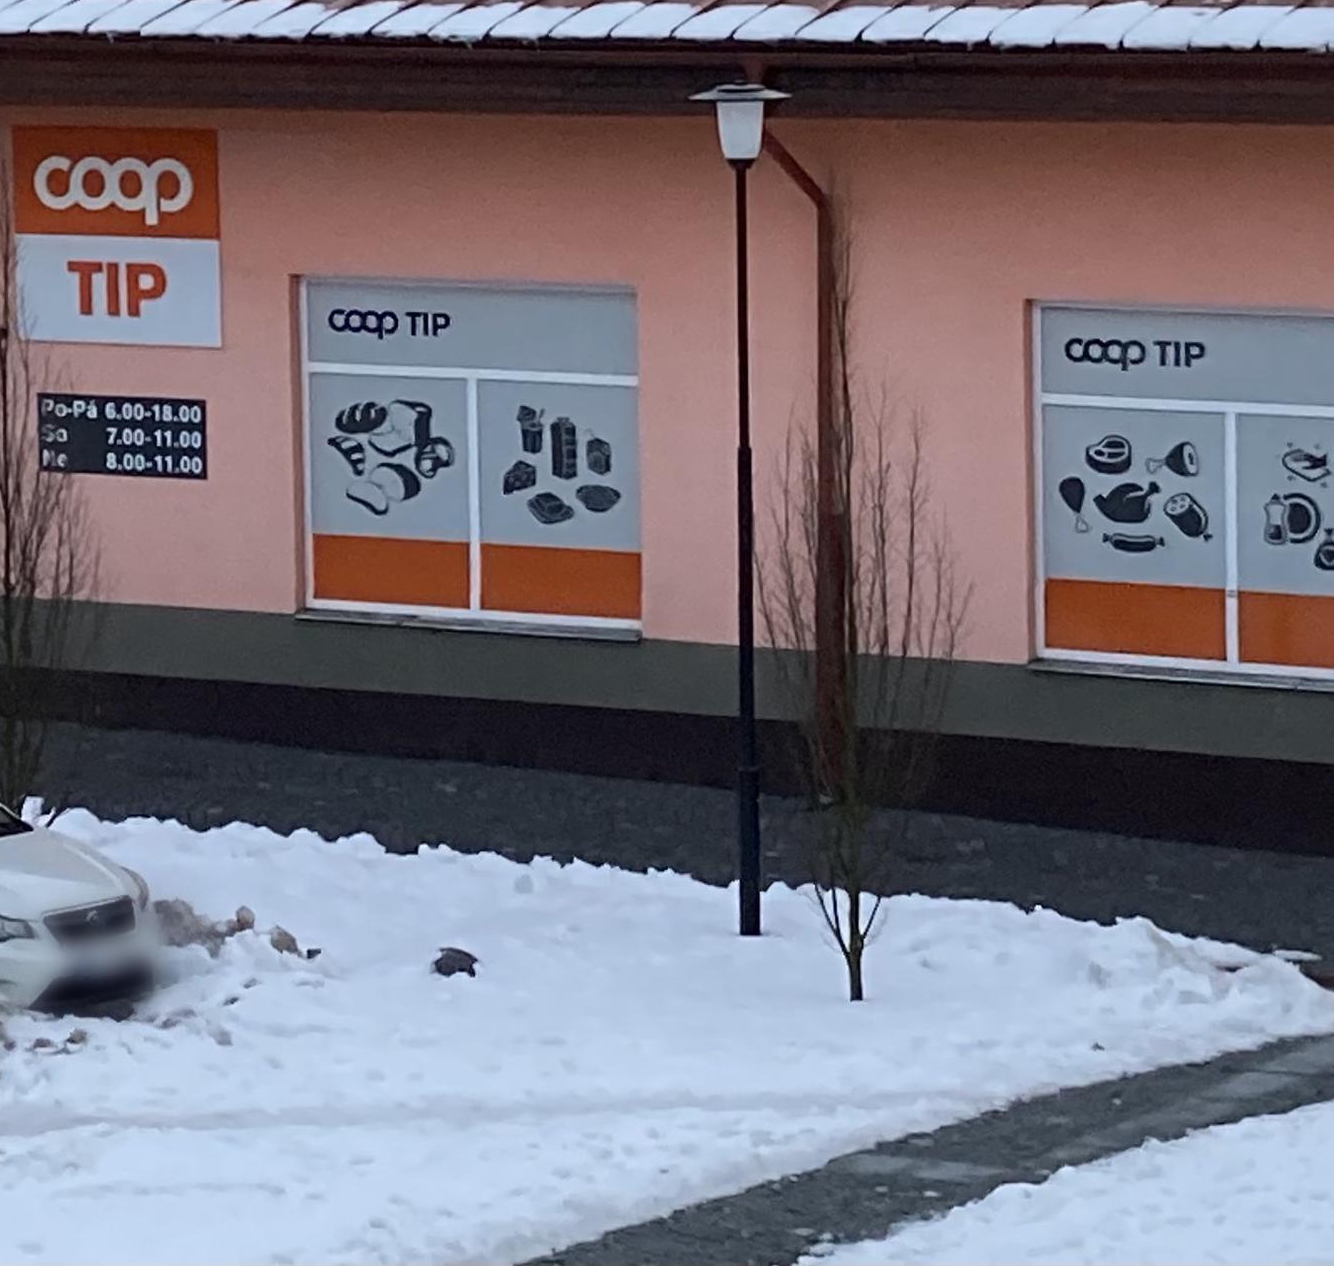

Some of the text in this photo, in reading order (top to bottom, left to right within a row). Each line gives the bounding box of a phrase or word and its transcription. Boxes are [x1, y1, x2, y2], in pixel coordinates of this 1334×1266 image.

[33, 155, 194, 226] coop
[67, 260, 168, 317] TIP
[328, 309, 451, 340] coop TIP
[1064, 338, 1206, 371] coop TIP
[105, 402, 202, 423] 6.00-18.00
[106, 427, 202, 448] 7.00-11.00
[106, 452, 203, 474] 8.00-11.00
